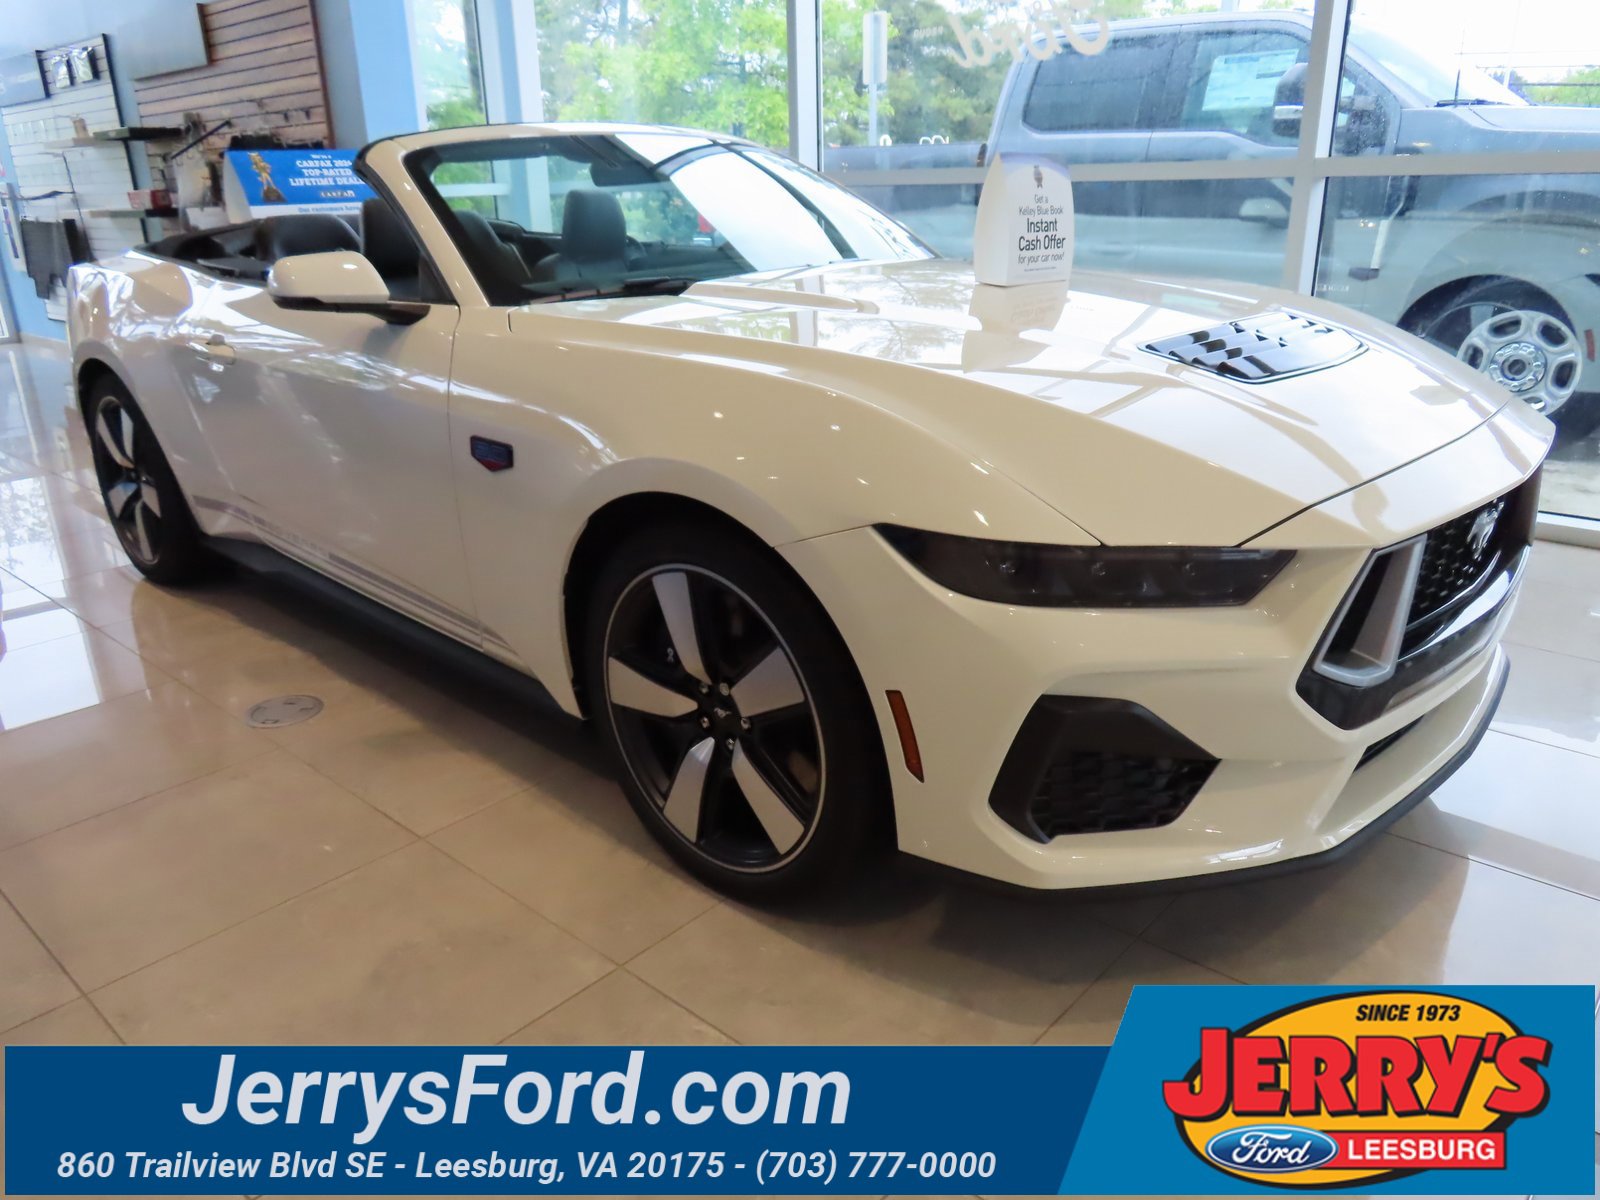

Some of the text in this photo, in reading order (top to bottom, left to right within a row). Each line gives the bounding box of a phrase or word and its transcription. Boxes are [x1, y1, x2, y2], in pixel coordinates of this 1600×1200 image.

[302, 168, 353, 176] TOP-RATED
[289, 177, 335, 186] LIFETIME
[1034, 194, 1044, 204] Get
[1019, 205, 1064, 217] Kelley Blue Book
[1027, 218, 1058, 233] Instant
[1018, 234, 1066, 252] Cash Offer
[1018, 254, 1027, 264] for
[1027, 255, 1041, 266] your
[1041, 254, 1051, 262] car
